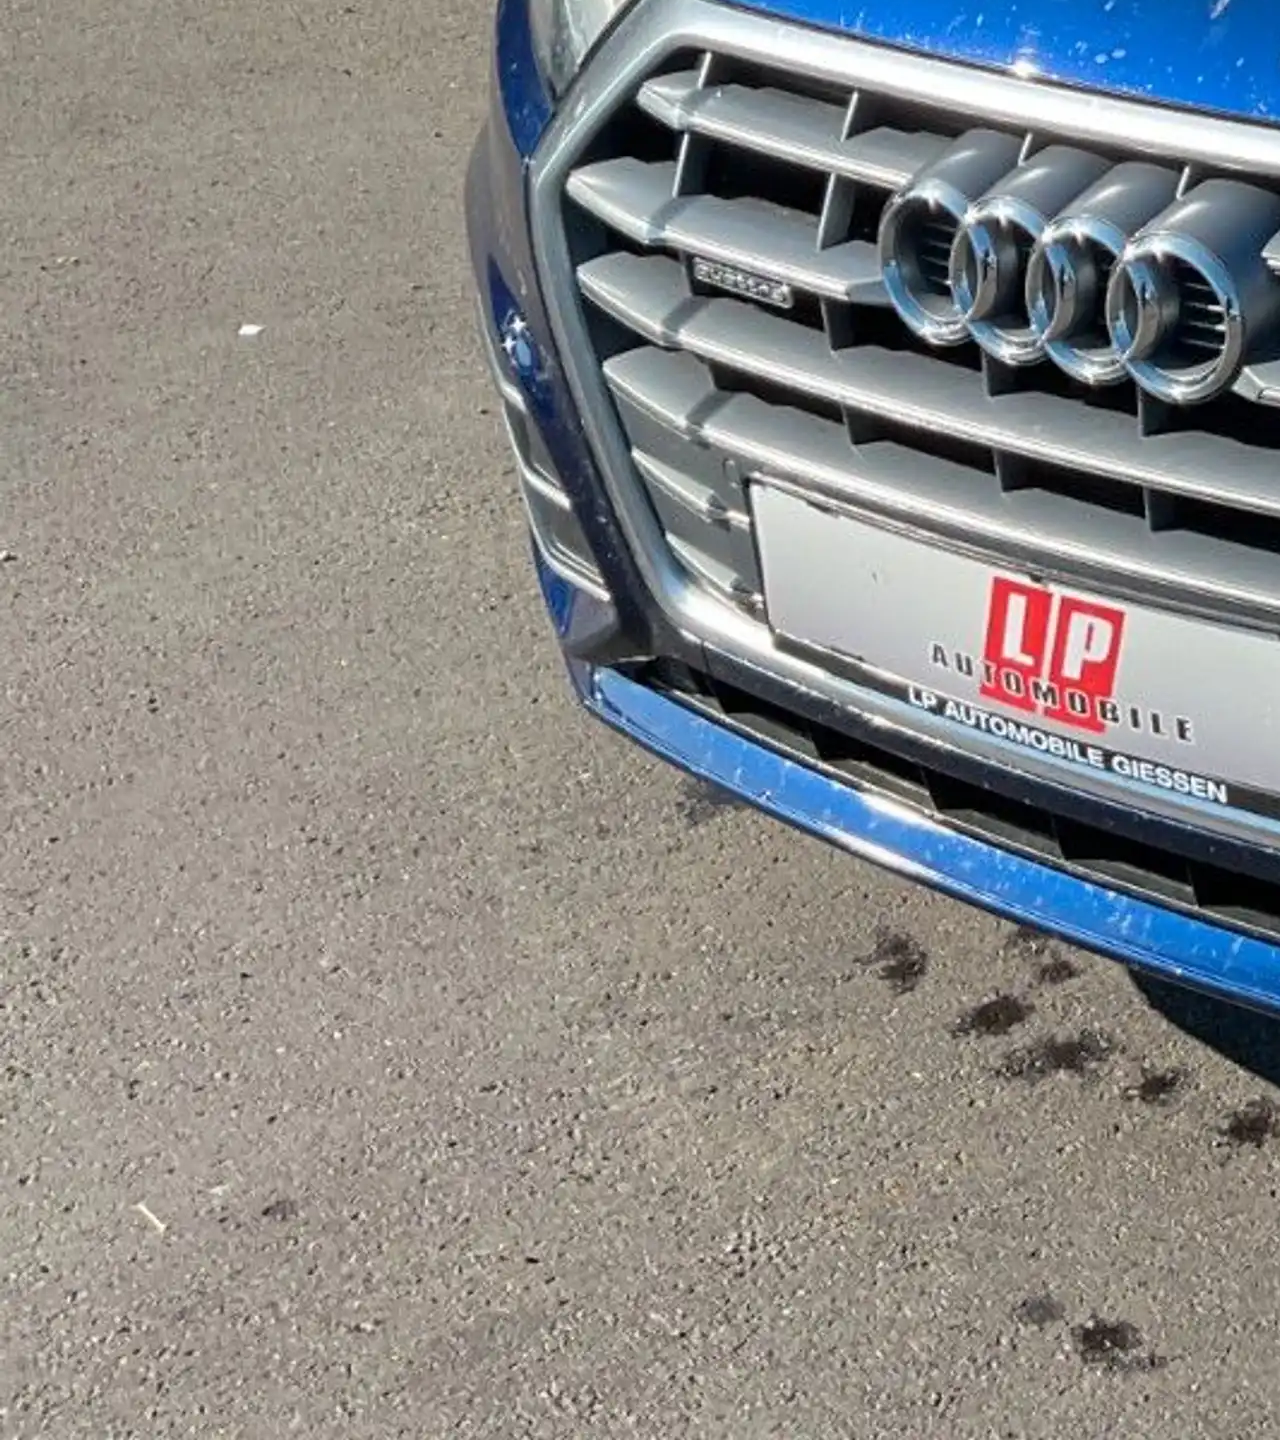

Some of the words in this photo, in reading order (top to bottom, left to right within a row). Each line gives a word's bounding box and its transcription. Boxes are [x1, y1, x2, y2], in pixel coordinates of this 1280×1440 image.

[1002, 592, 1115, 681] LP
[931, 643, 1193, 744] AUTOMOBILE
[908, 685, 939, 711] LP
[945, 700, 1106, 769] AUTOMOBILE
[1112, 754, 1228, 805] GIESSEN
